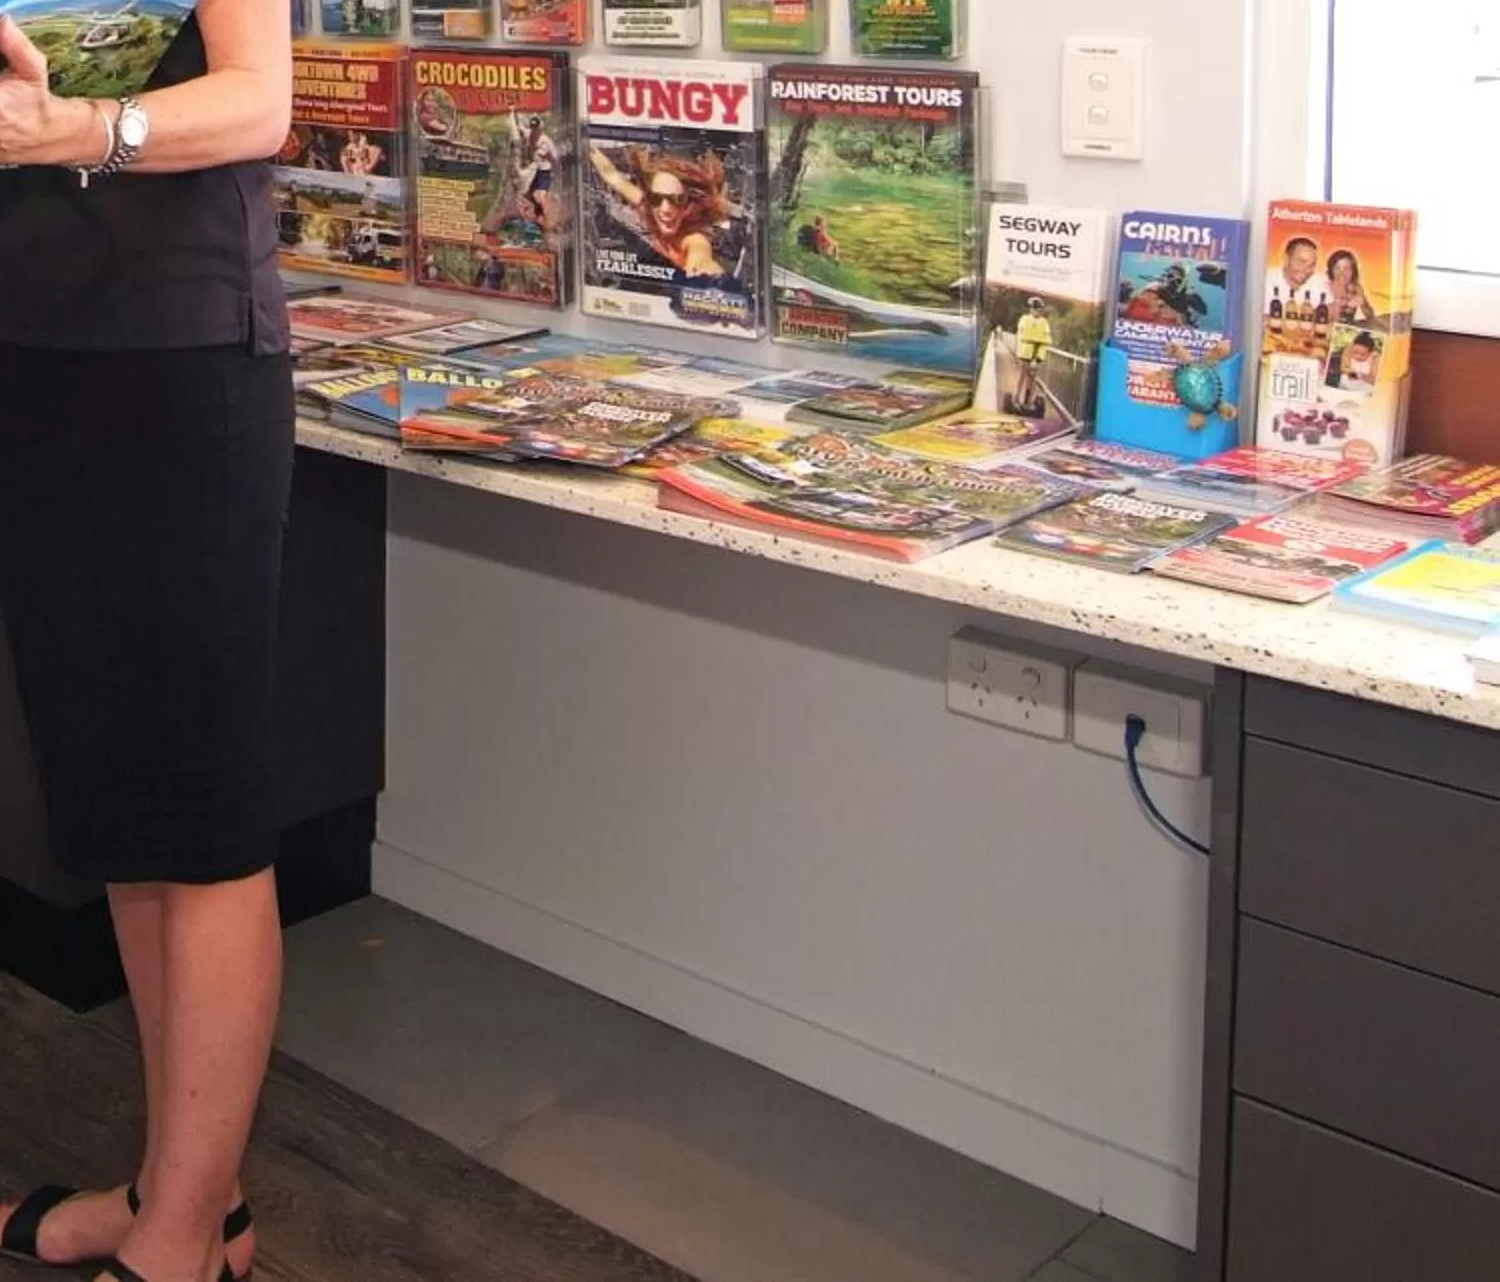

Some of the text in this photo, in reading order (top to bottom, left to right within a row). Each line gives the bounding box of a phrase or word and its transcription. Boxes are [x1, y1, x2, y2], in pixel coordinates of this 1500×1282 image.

[415, 60, 547, 91] CROCODILES
[293, 79, 368, 98] DVENTURES
[587, 74, 750, 125] BUNGY
[771, 79, 890, 104] RAINFOREST
[894, 85, 963, 107] TOURS
[999, 214, 1082, 237] SEGWAY
[1272, 207, 1388, 231] Atherton Tablelands
[1006, 237, 1072, 259] TOURS
[596, 259, 677, 280] FEARLESSLY
[781, 320, 848, 345] COMPANY
[1115, 318, 1224, 340] UNDERWATER
[406, 368, 504, 389] BALLO
[1272, 368, 1312, 400] trail
